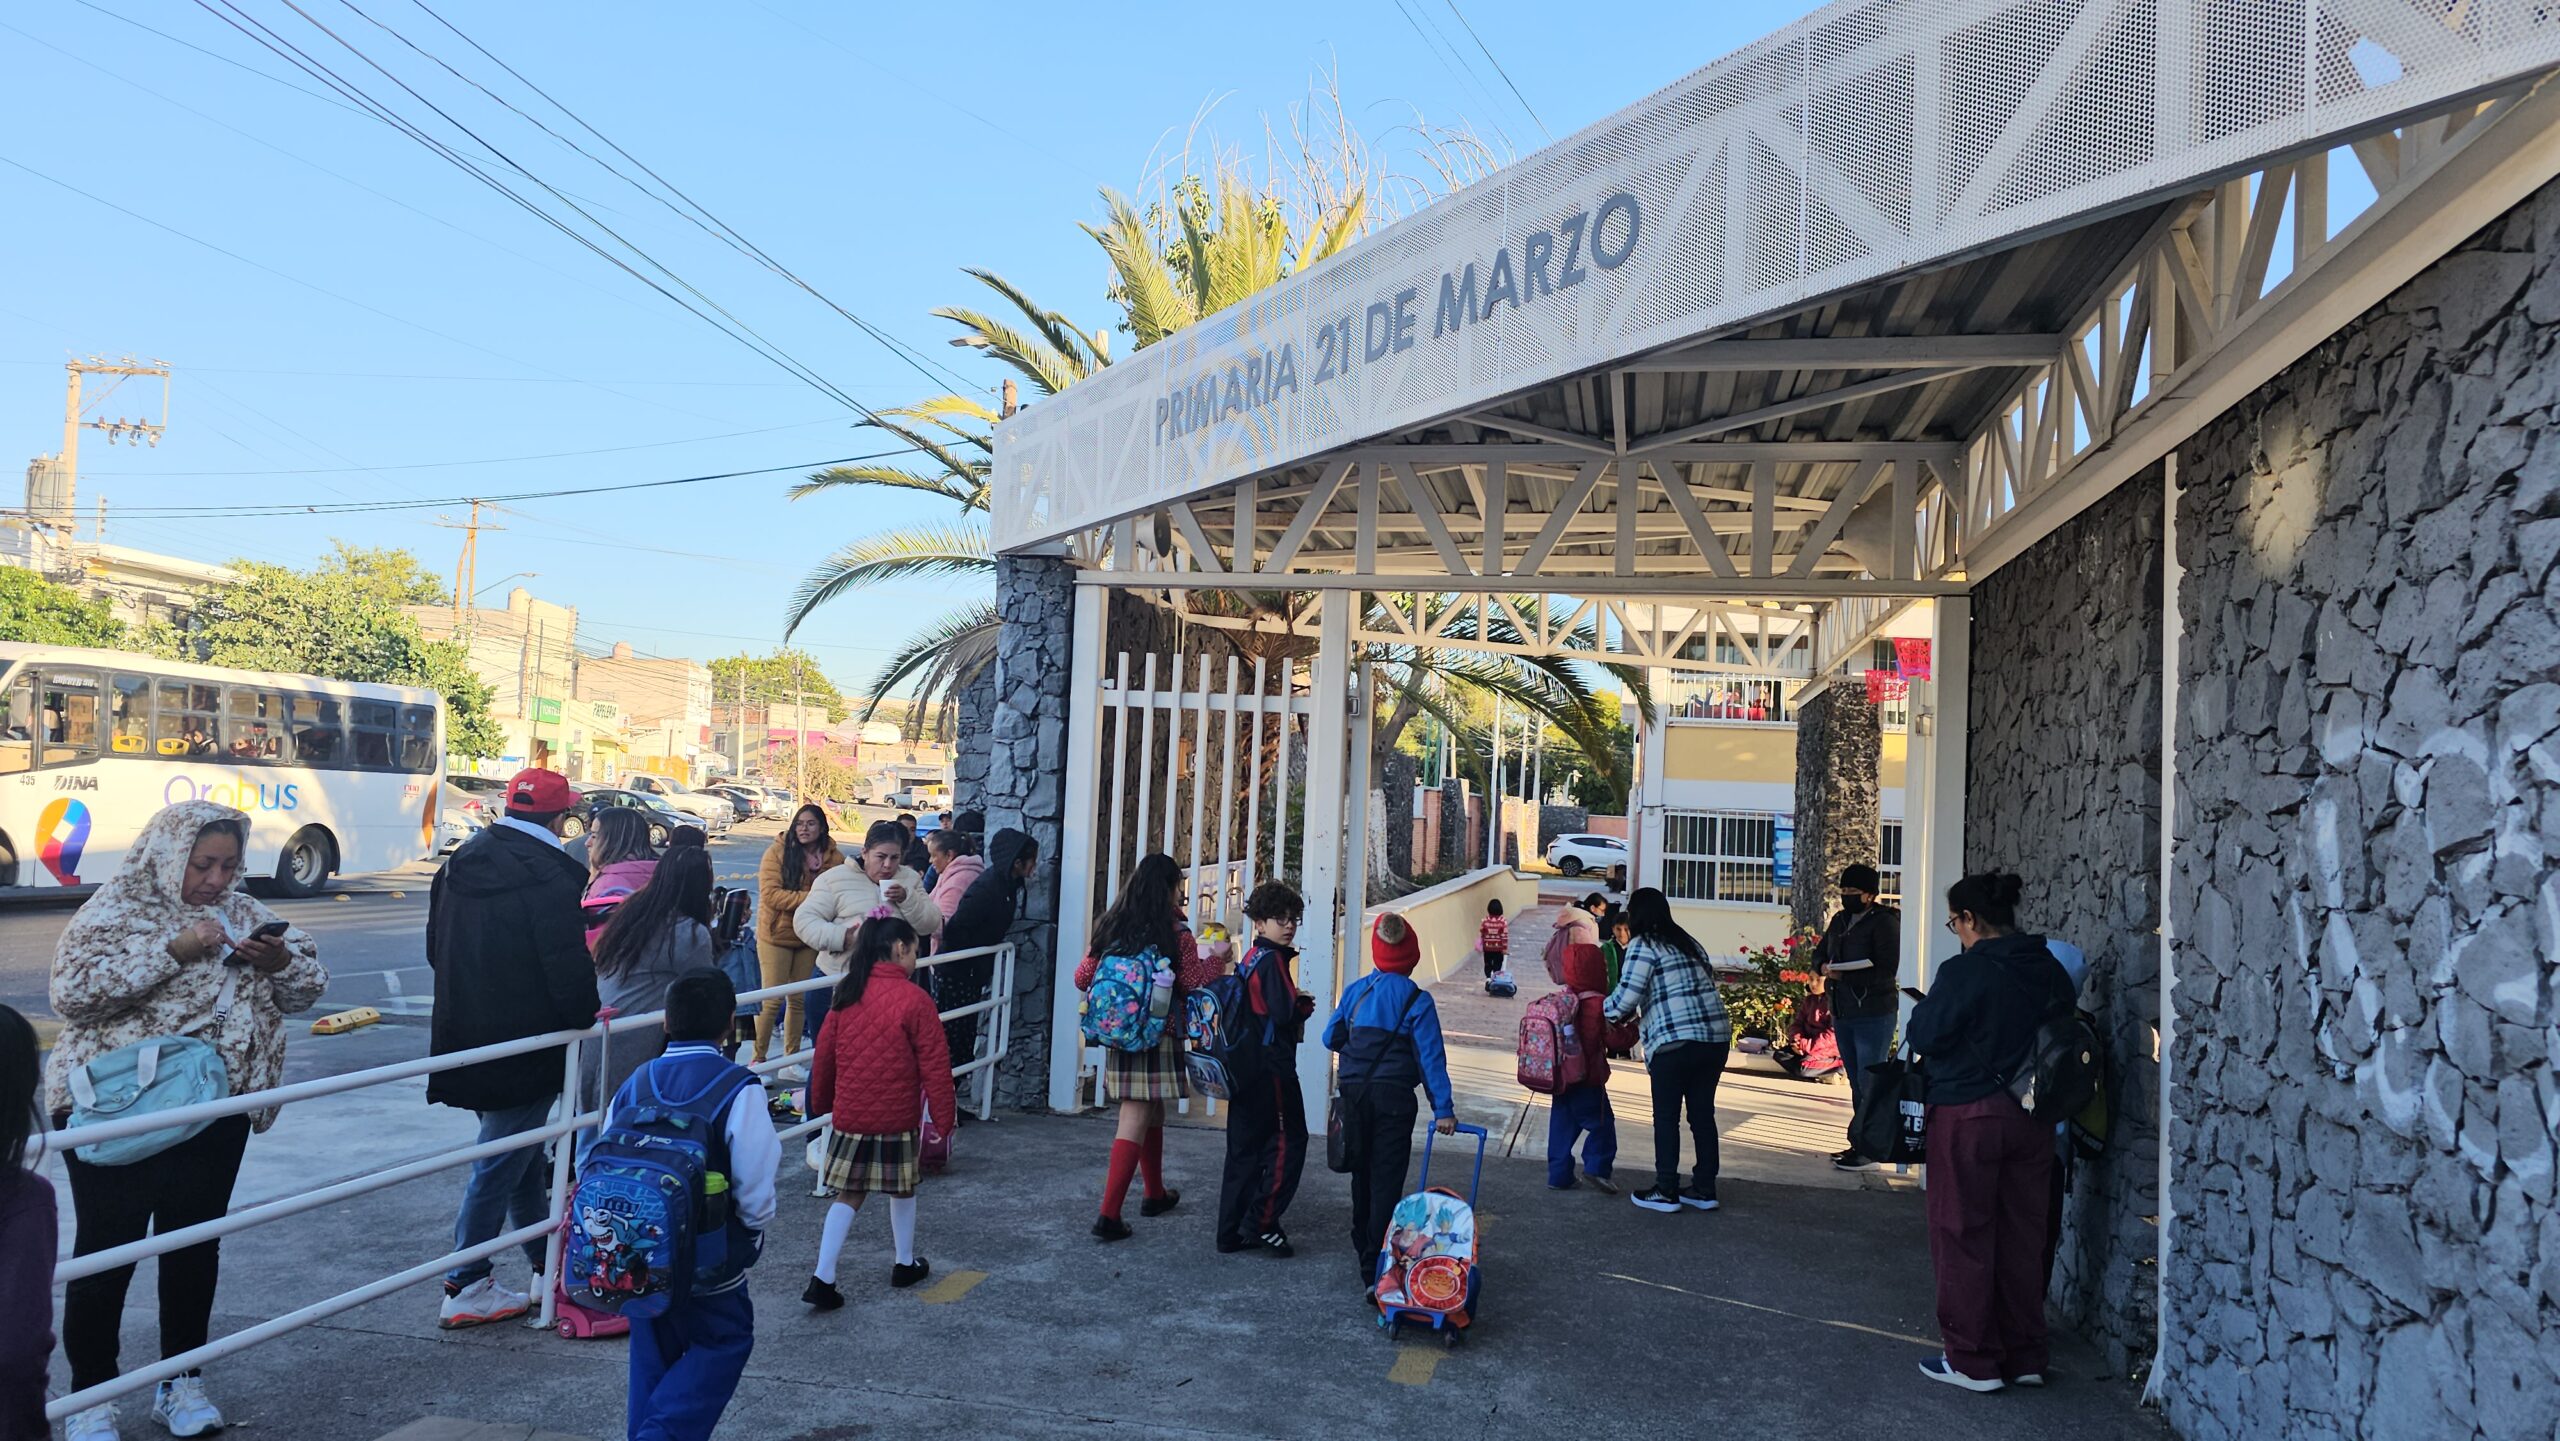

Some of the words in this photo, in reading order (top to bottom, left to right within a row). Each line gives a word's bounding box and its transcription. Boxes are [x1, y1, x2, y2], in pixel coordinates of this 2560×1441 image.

[1155, 343, 1297, 446] PRIMARIA
[1313, 316, 1350, 386] 21
[1365, 288, 1415, 364] DE
[1433, 192, 1641, 339] MARZO
[20, 774, 35, 786] 435
[54, 775, 98, 791] DINA
[164, 769, 298, 811] Orobus
